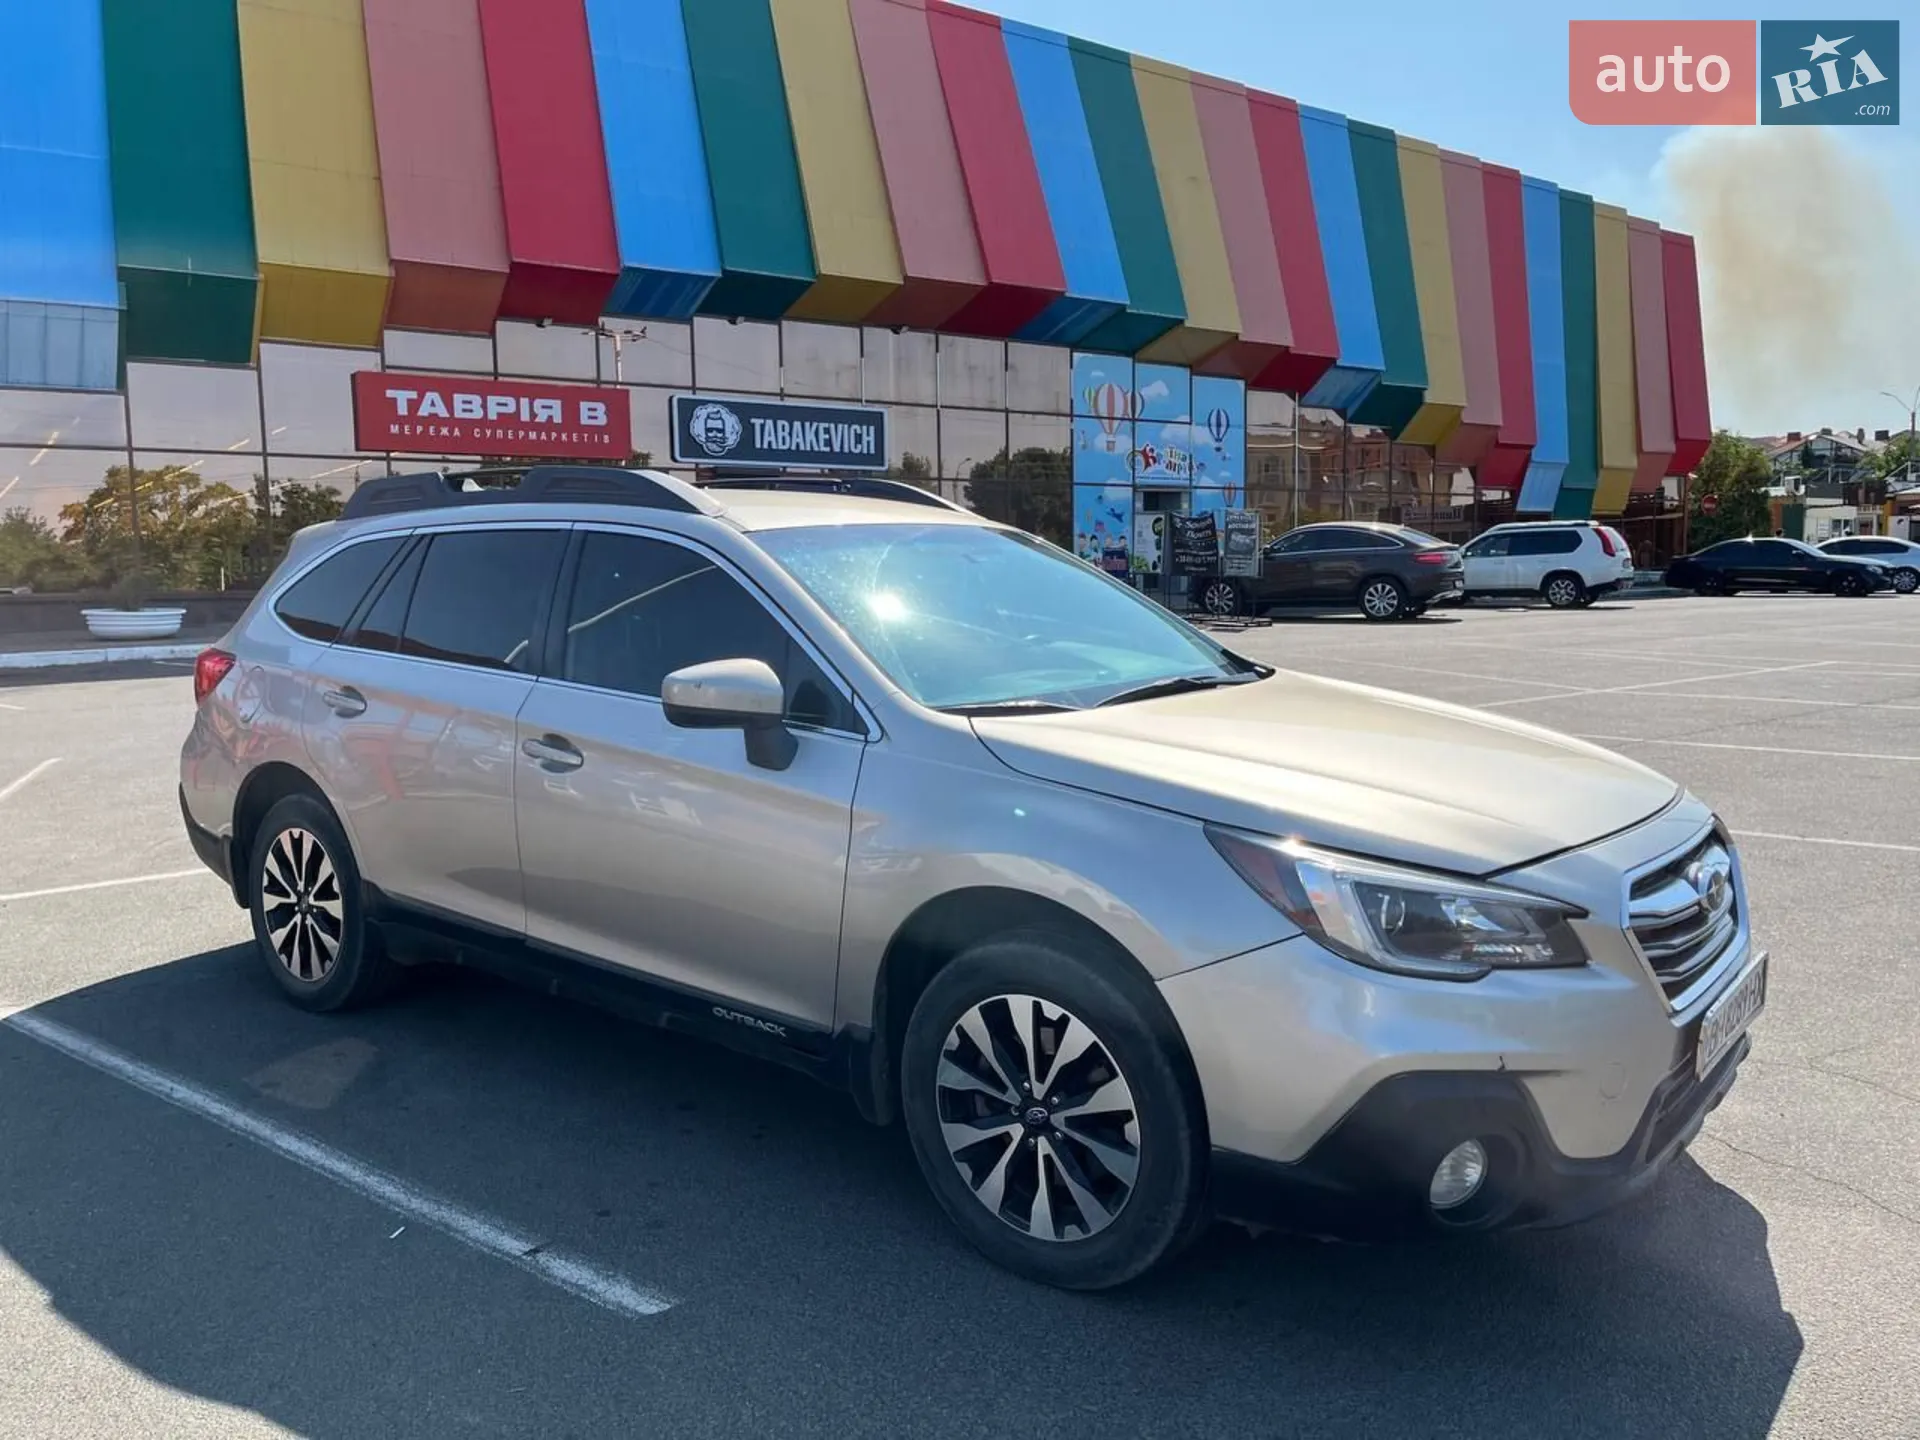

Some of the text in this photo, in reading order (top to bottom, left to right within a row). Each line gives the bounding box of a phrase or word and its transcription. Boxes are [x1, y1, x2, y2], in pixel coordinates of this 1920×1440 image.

[385, 389, 608, 426] ТАВРІЯ В
[390, 424, 611, 444] МЕРЕЖА СУПЕРМАРКЕТІВ
[750, 417, 876, 455] TABAKEVICH
